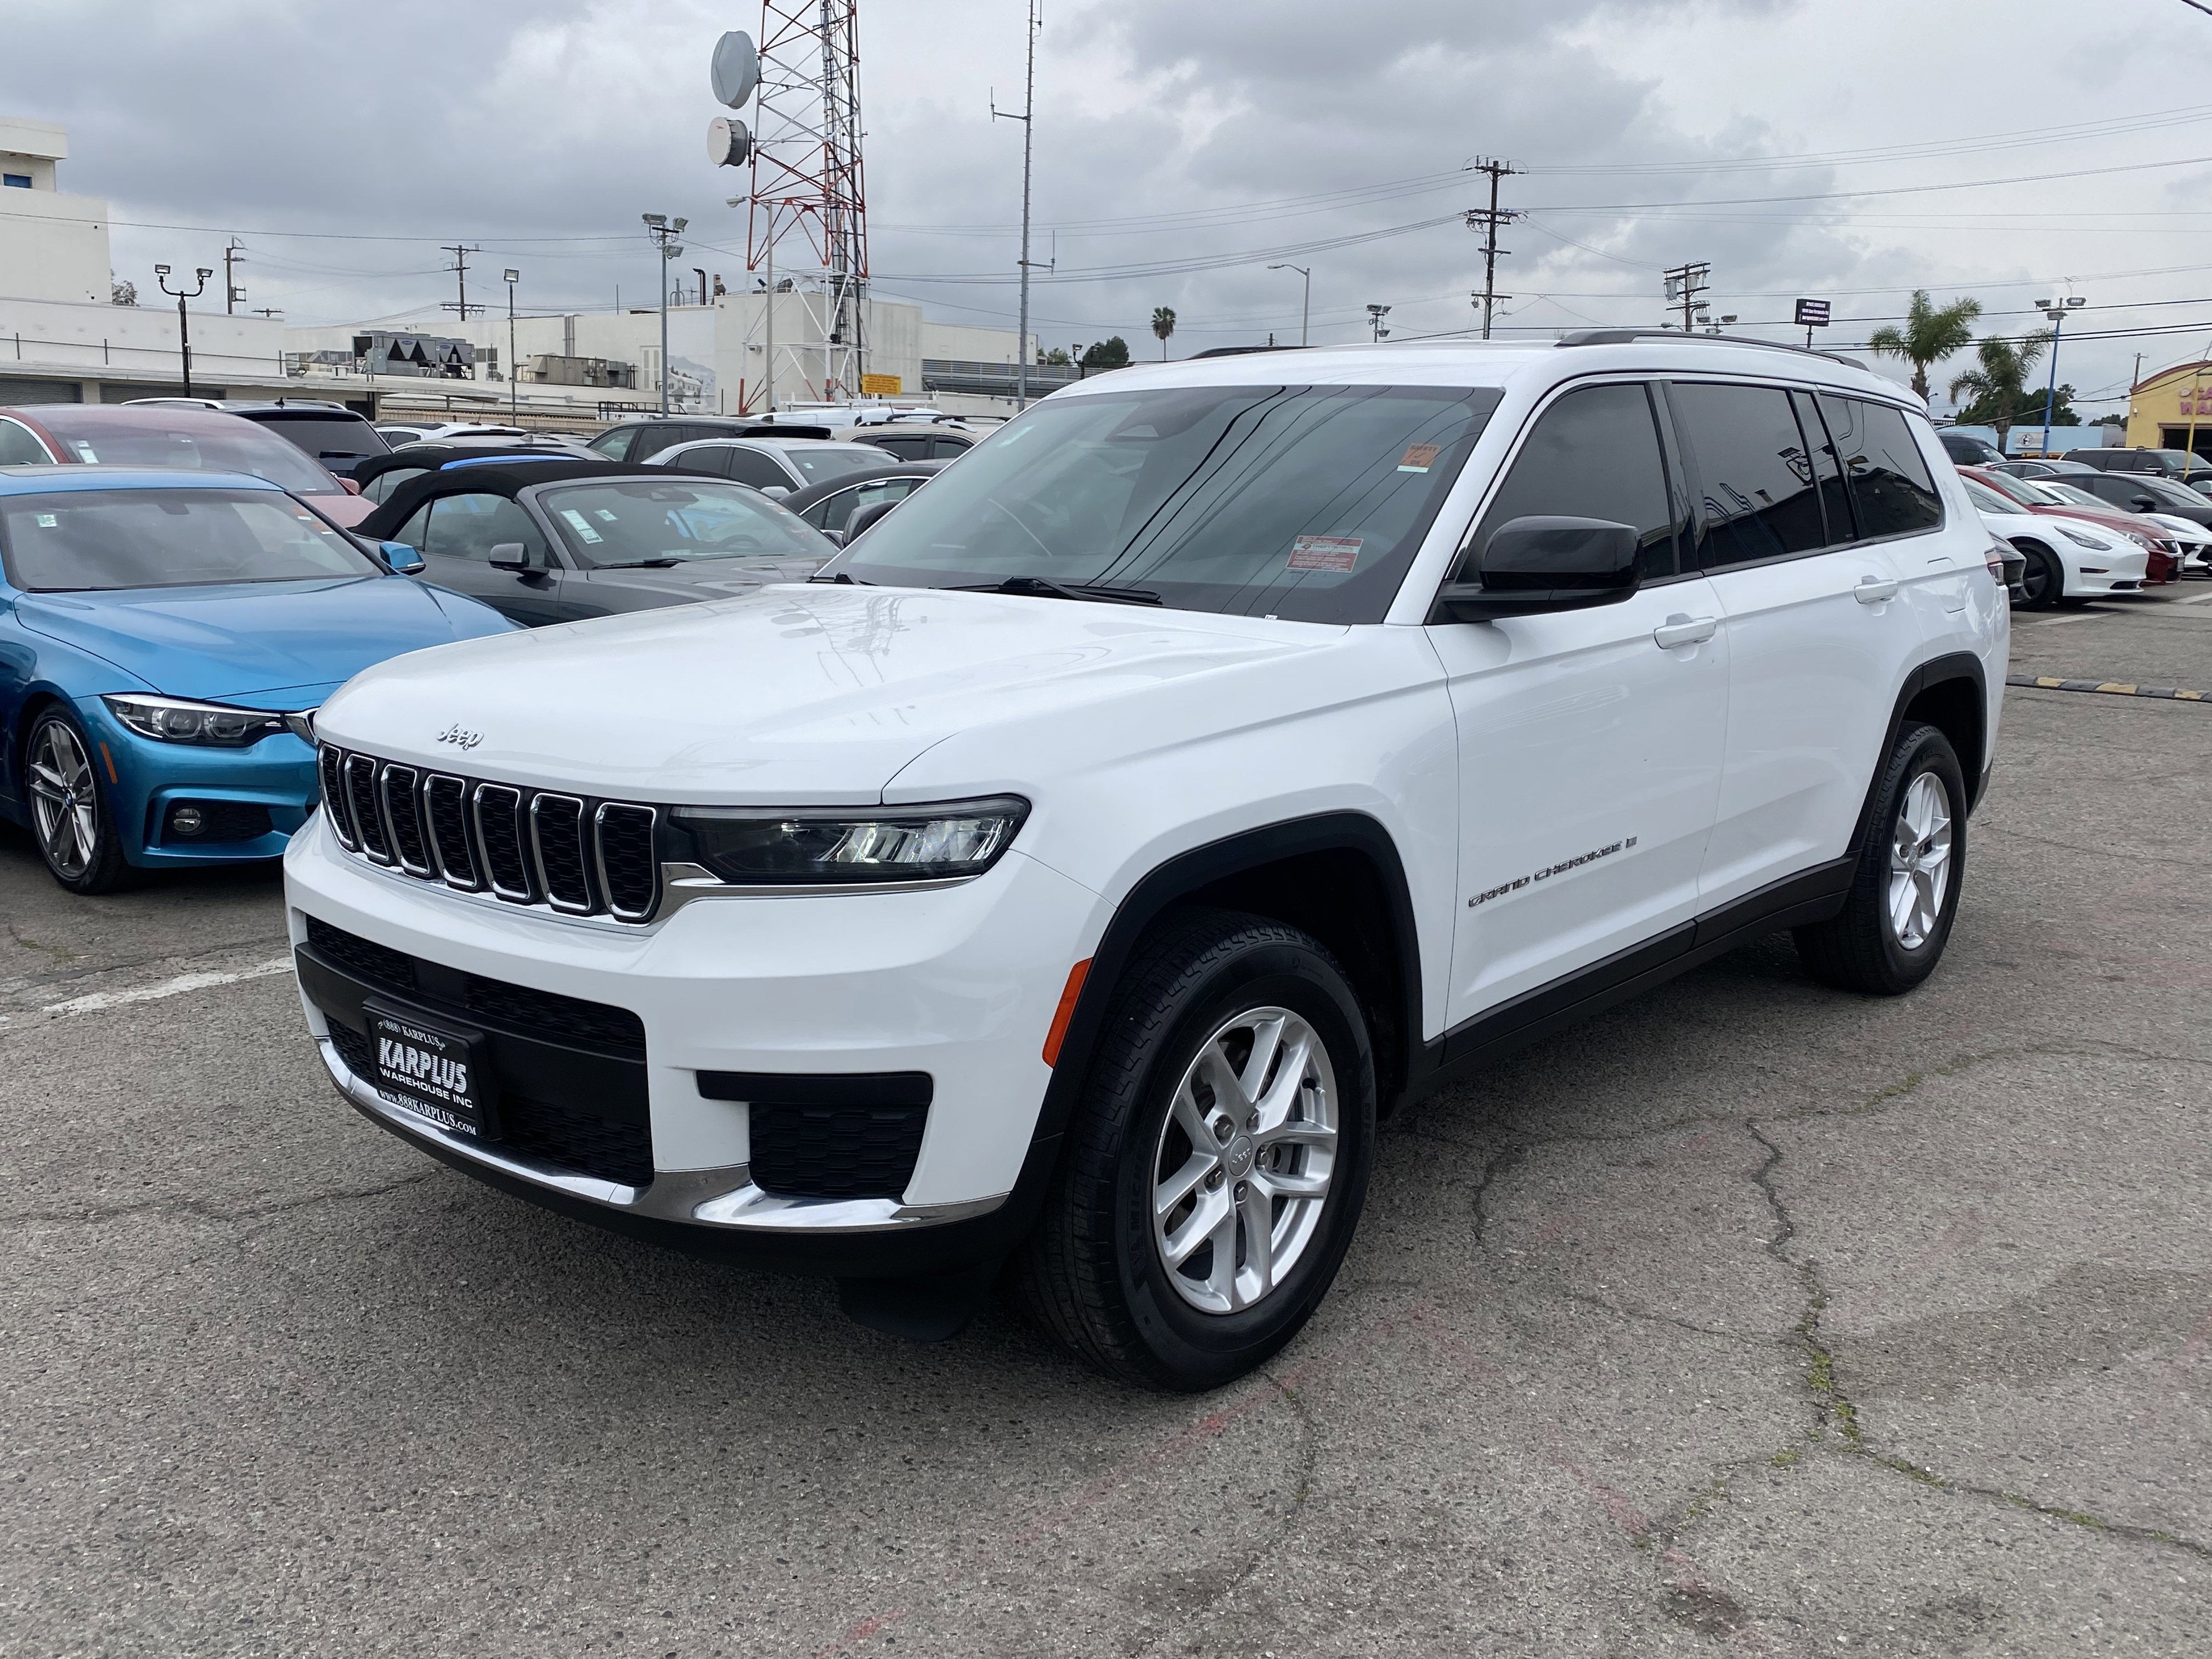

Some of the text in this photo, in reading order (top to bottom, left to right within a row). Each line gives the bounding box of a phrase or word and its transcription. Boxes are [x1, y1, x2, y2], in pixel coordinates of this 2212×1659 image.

[436, 723, 484, 750] Jeep
[1469, 840, 1622, 907] GRAND CHEROKEE
[383, 1019, 439, 1047] (888) KARPLUS
[378, 1037, 467, 1093] KARPLUS
[379, 1067, 472, 1108] WAREHOUSE INC
